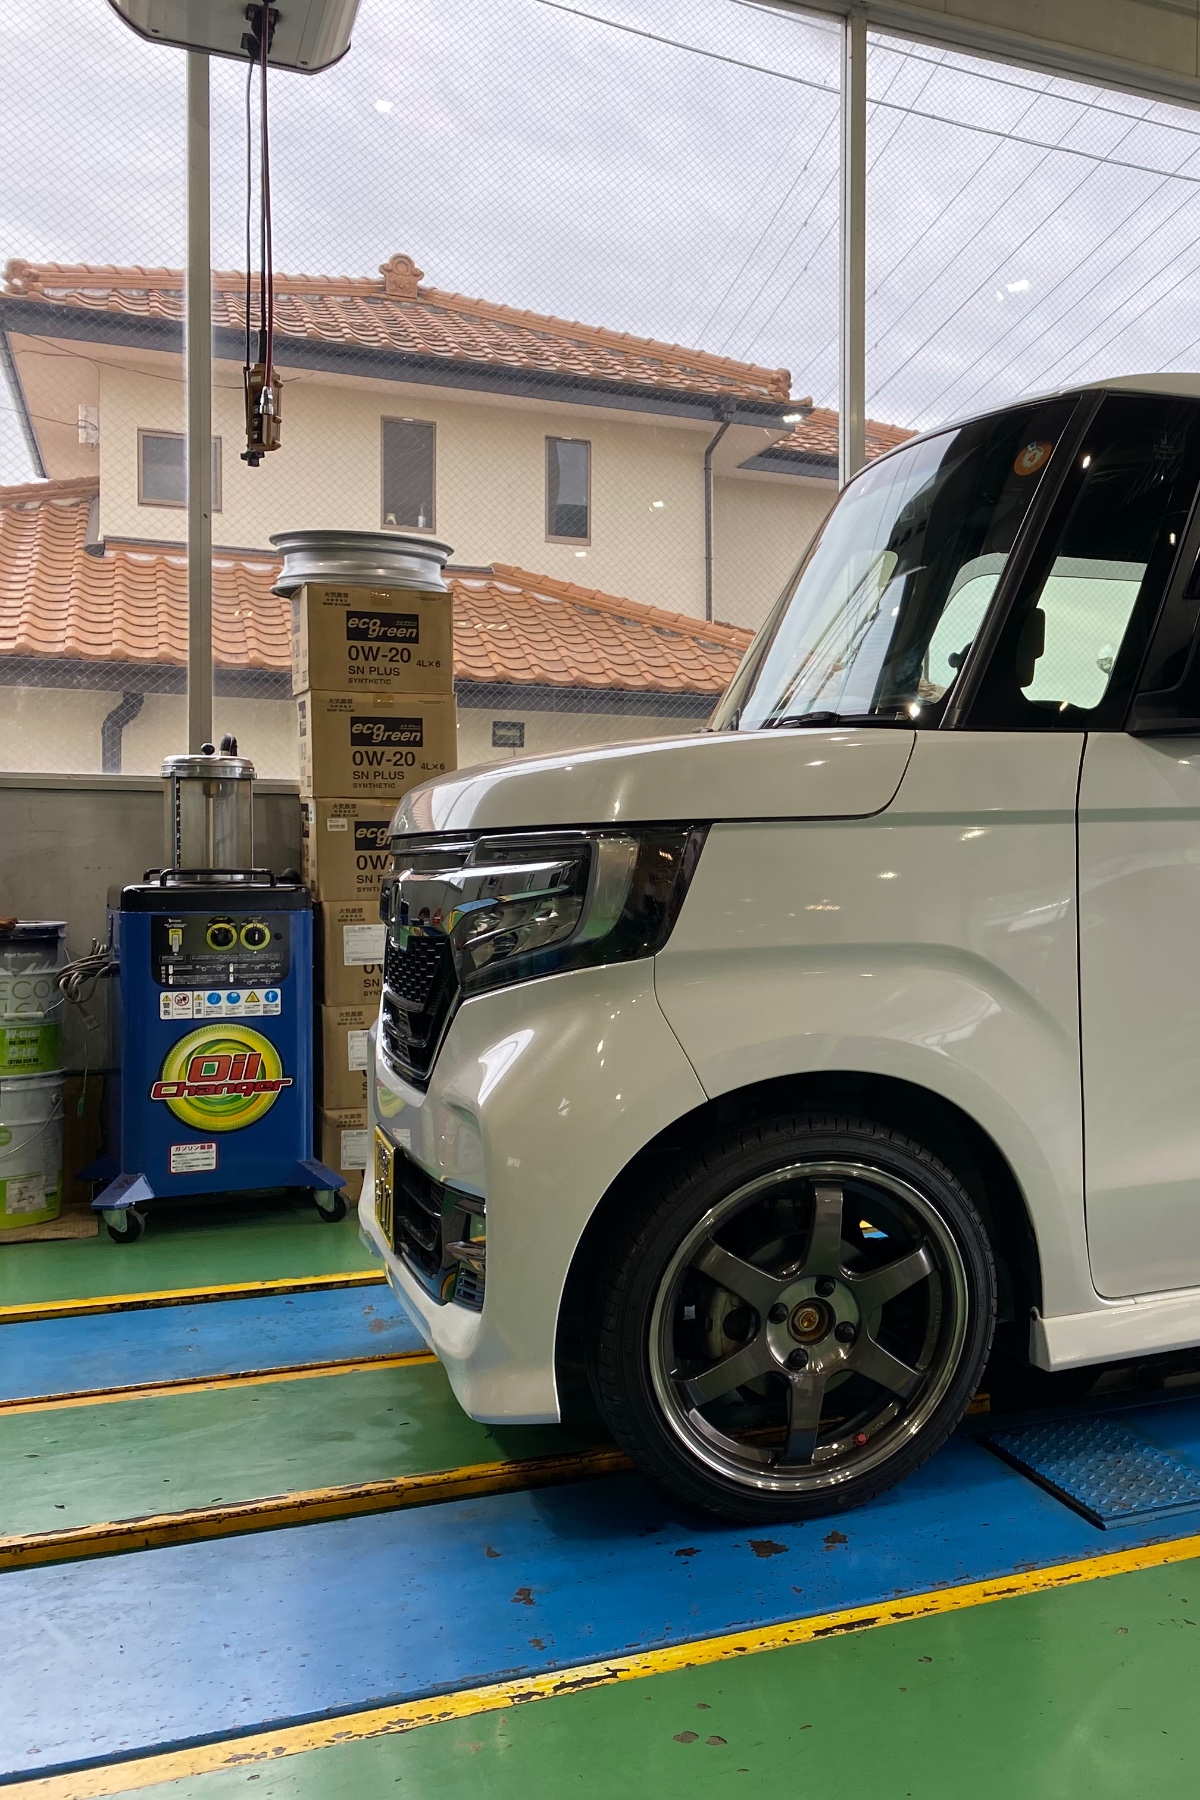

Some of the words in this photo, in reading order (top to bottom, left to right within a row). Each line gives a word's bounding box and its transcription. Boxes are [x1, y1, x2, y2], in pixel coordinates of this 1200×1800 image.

[347, 617, 381, 629] eco
[367, 626, 418, 638] green
[347, 645, 412, 663] 0W-20
[348, 665, 365, 675] SN
[369, 666, 400, 676] PLUS
[348, 677, 392, 685] SYNTHETIC
[351, 723, 385, 735] eco
[371, 731, 421, 743] green
[352, 750, 416, 767] 0W-20
[352, 771, 370, 780] SN
[373, 771, 405, 781] PLUS
[356, 874, 373, 884] SN
[363, 979, 380, 988] SN
[187, 1052, 262, 1084] Oil
[151, 1078, 293, 1100] Changer
